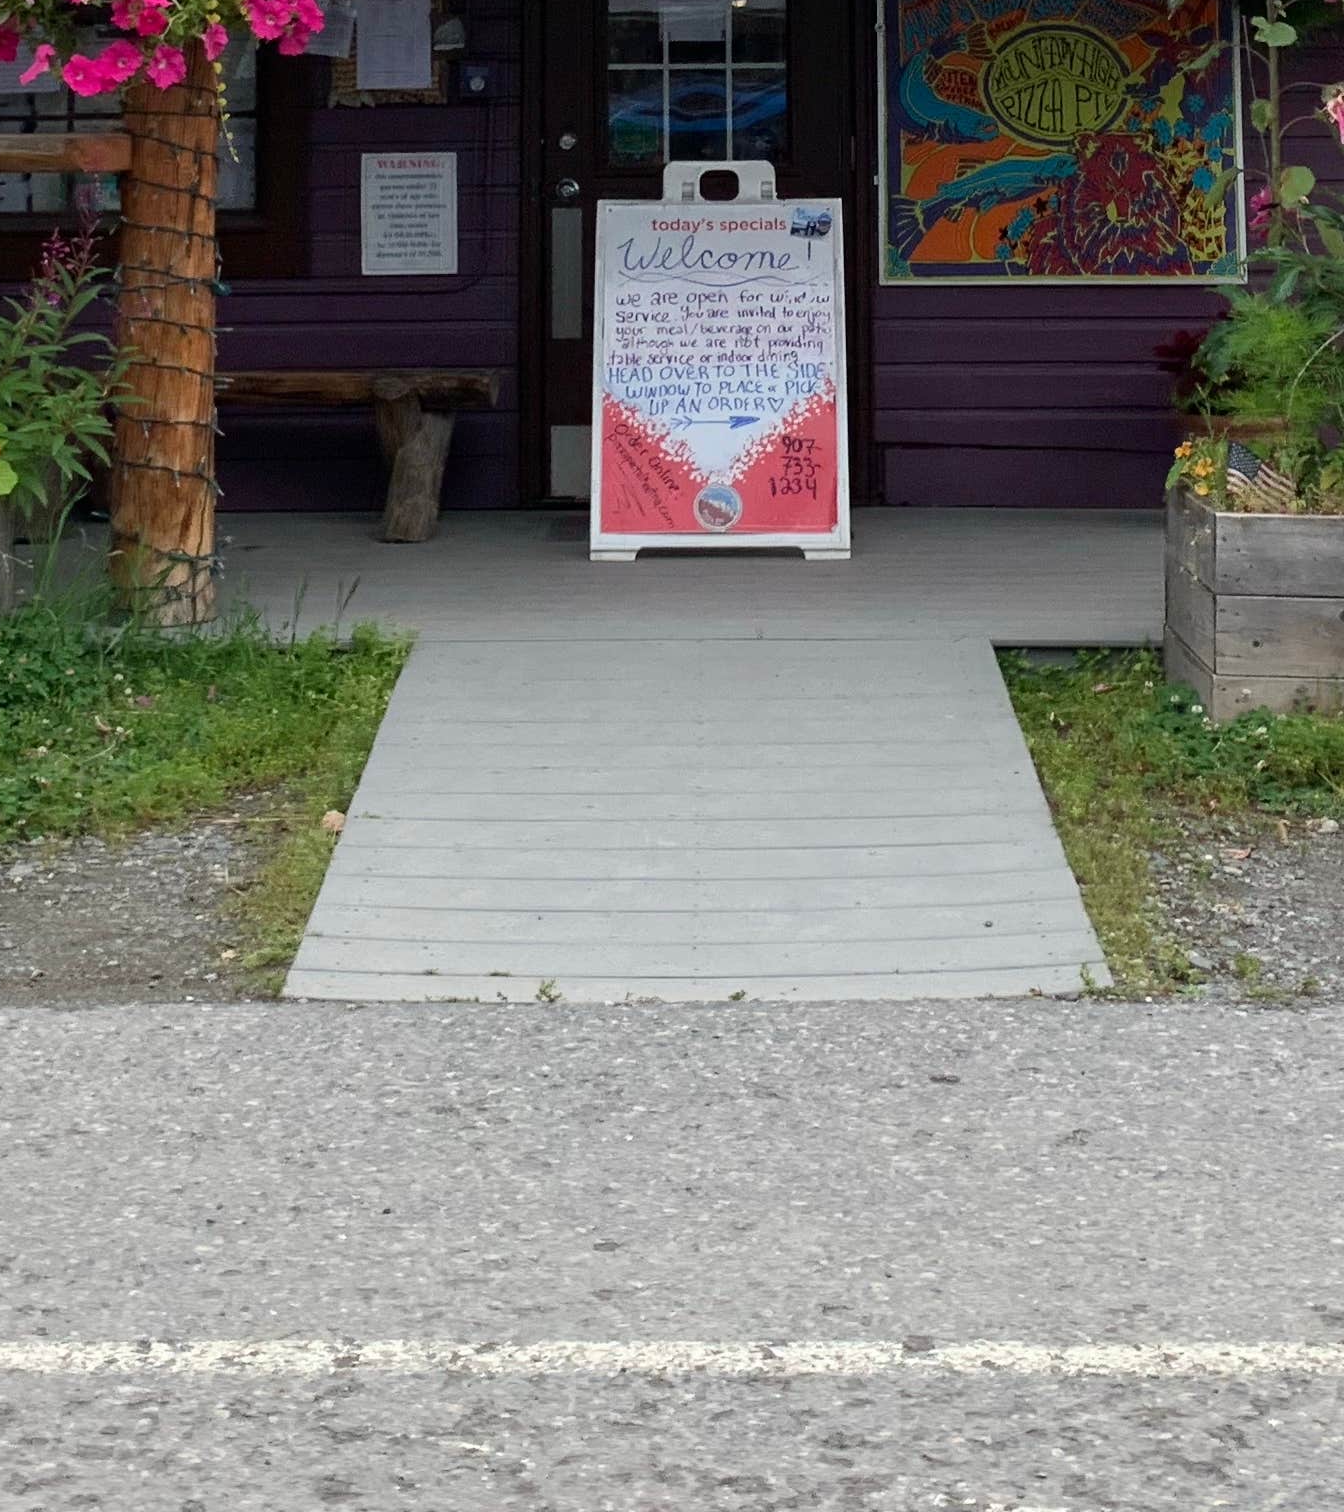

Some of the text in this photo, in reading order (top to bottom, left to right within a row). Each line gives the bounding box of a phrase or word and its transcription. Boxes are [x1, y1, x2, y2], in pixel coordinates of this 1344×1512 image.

[999, 78, 1065, 133] PIZZA
[652, 217, 787, 234] today's specials
[616, 294, 642, 307] we
[650, 291, 678, 306] are
[686, 290, 729, 309] open
[740, 290, 763, 304] for
[707, 307, 729, 319] are
[782, 306, 797, 319] to
[796, 308, 832, 326] enjoy
[616, 325, 645, 338] your
[755, 324, 772, 334] on
[679, 338, 698, 349] we
[705, 338, 727, 349] are
[646, 350, 695, 365] service
[699, 353, 714, 364] or
[608, 365, 654, 385] HEAD
[658, 364, 710, 381] OVER
[713, 363, 736, 378] TO
[742, 362, 781, 379] THE
[624, 383, 692, 399] WINDOW
[694, 380, 712, 397] TO
[718, 379, 764, 396] PLACE
[648, 395, 767, 417] UP AN ORDER
[613, 423, 649, 457] Order
[767, 476, 818, 501] 1234
